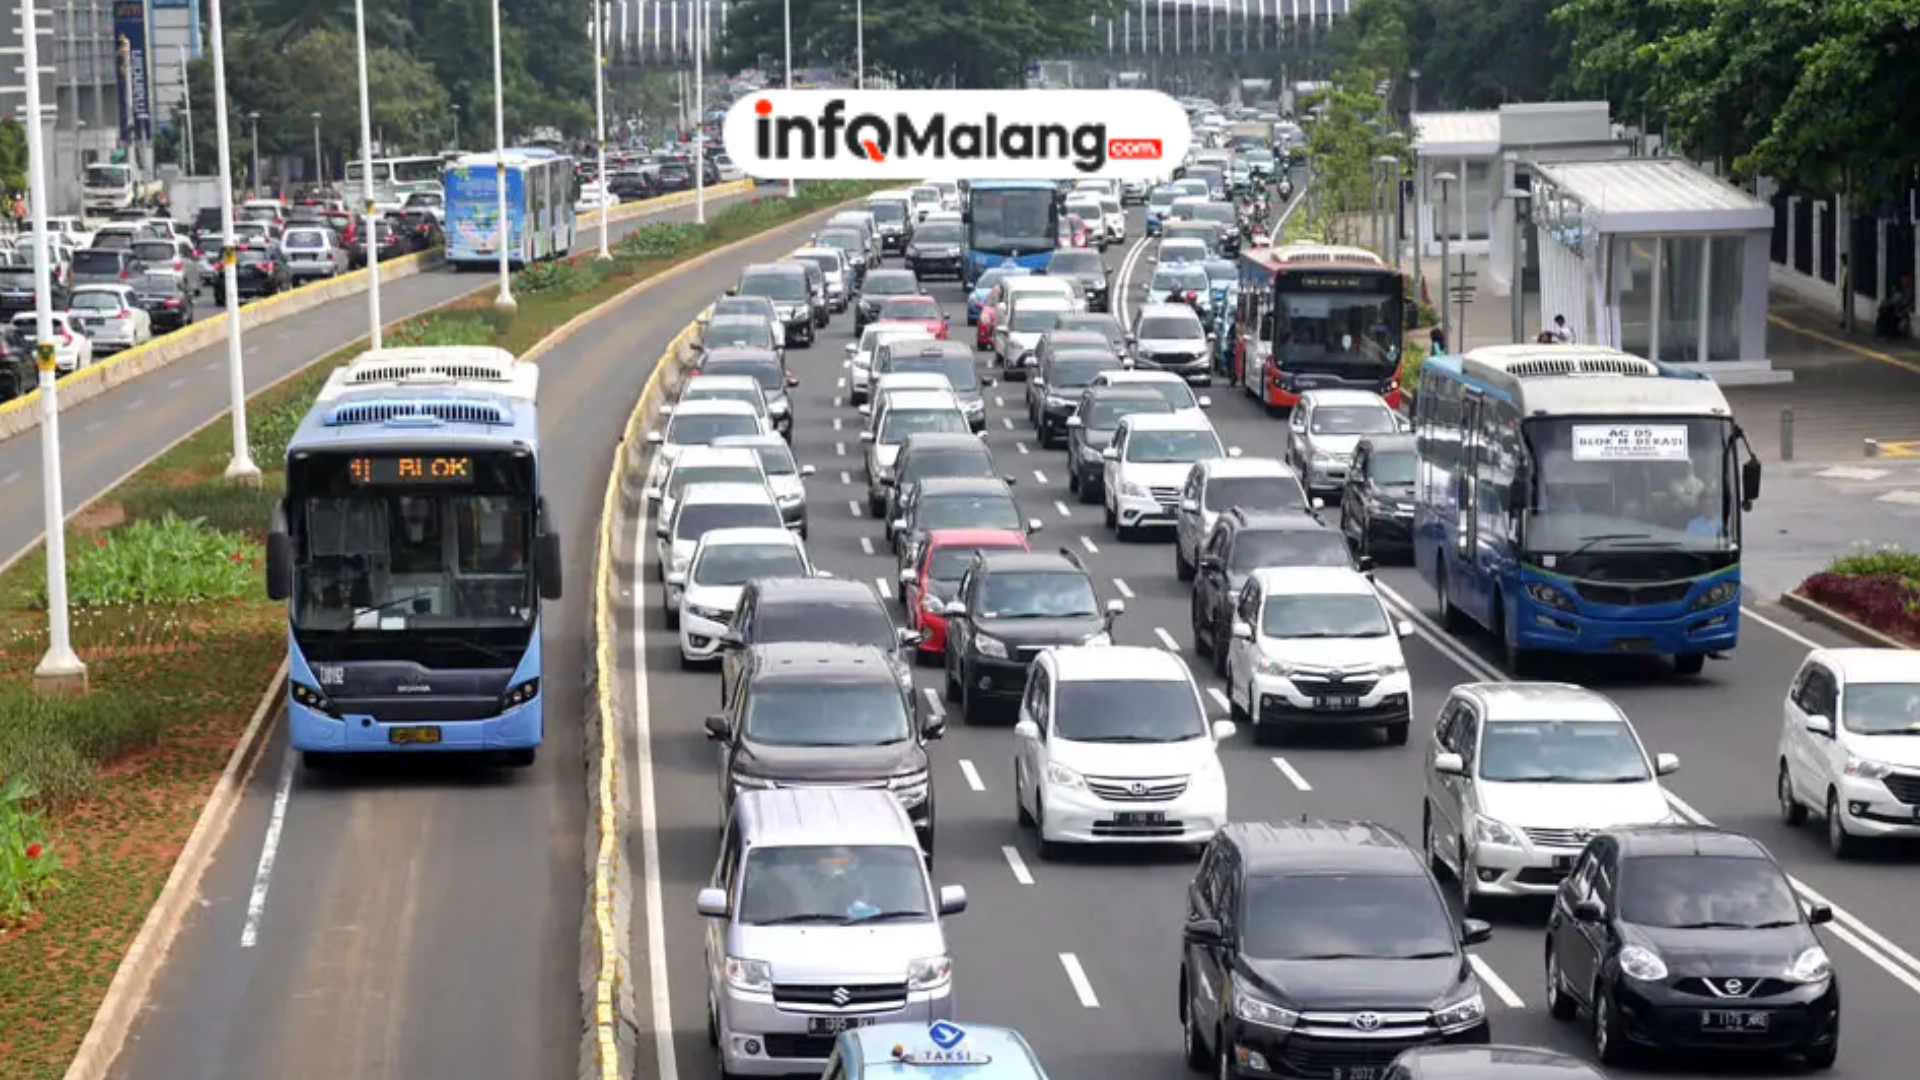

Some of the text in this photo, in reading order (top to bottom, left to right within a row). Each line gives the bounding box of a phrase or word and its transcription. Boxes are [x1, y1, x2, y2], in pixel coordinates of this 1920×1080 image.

[1609, 429, 1629, 437] AC
[1579, 438, 1612, 446] BLOK
[924, 1051, 971, 1061] TAKSI
